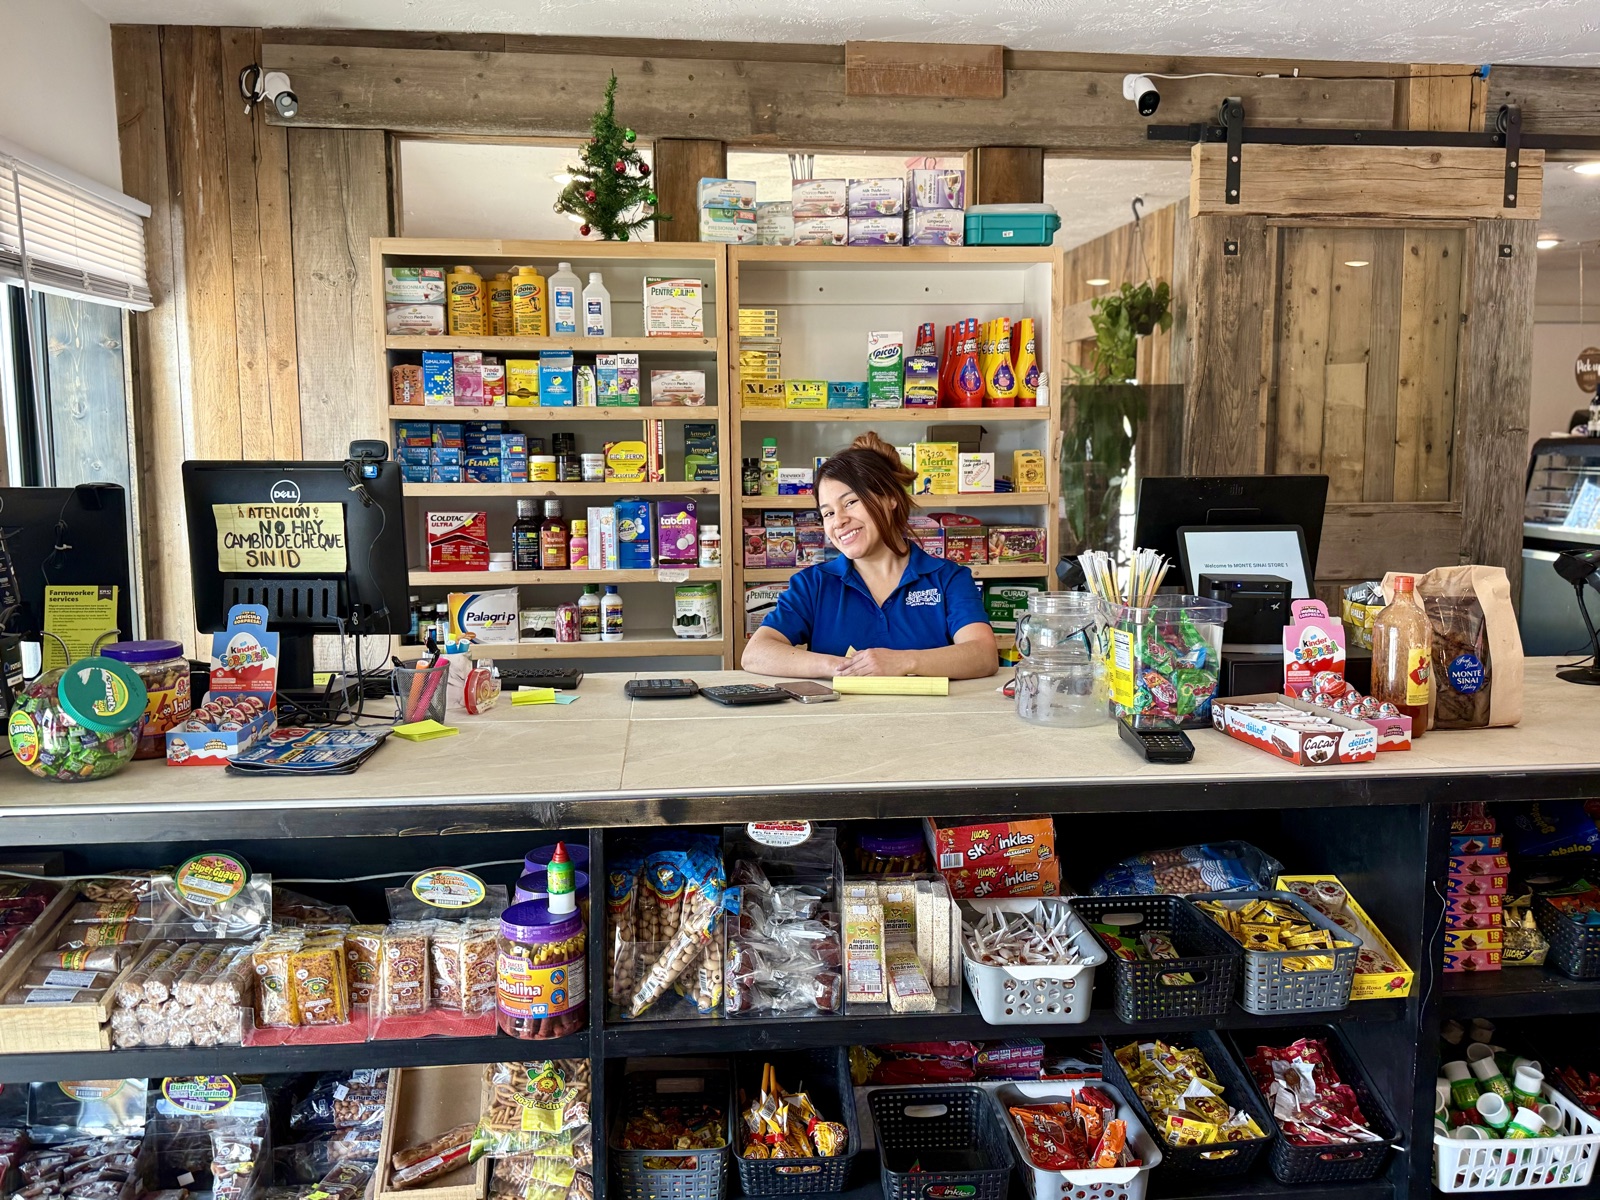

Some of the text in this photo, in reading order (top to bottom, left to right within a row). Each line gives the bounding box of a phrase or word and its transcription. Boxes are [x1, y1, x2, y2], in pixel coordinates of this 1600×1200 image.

[874, 348, 899, 360] picot
[598, 358, 616, 366] Tukol
[619, 357, 637, 365] Tukol
[746, 384, 785, 394] XL-3
[792, 384, 821, 392] XL-3
[468, 458, 499, 467] FLANAX
[274, 491, 298, 499] DELL
[430, 514, 464, 522] COLDTAC
[259, 520, 324, 535] NO HAY
[224, 532, 344, 550] CAMBIO DE CHEQUE
[246, 550, 301, 568] SIN ID
[1351, 588, 1366, 600] HALLS
[466, 612, 516, 626] Palagrip
[1350, 609, 1364, 621] HALLS
[1302, 636, 1328, 648] Kinder
[230, 644, 258, 654] Kinder
[1294, 641, 1339, 661] SORPRESA
[220, 647, 270, 668] SORPRESA
[1451, 669, 1482, 678] MONTE
[1456, 677, 1479, 685] SINAI
[1304, 736, 1339, 751] Cacao
[970, 829, 991, 842] LUCAS
[1491, 836, 1501, 845] 18
[1496, 856, 1507, 865] 18
[212, 868, 241, 882] Guava
[977, 868, 998, 879] LUCAS
[1493, 877, 1504, 885] 18
[1488, 895, 1499, 903] 18
[1491, 913, 1501, 922] 18
[1490, 931, 1500, 940] 18
[1489, 953, 1500, 961] 18
[1502, 948, 1526, 960] LUCAS
[532, 1005, 546, 1014] 40
[535, 1100, 566, 1112] Super
